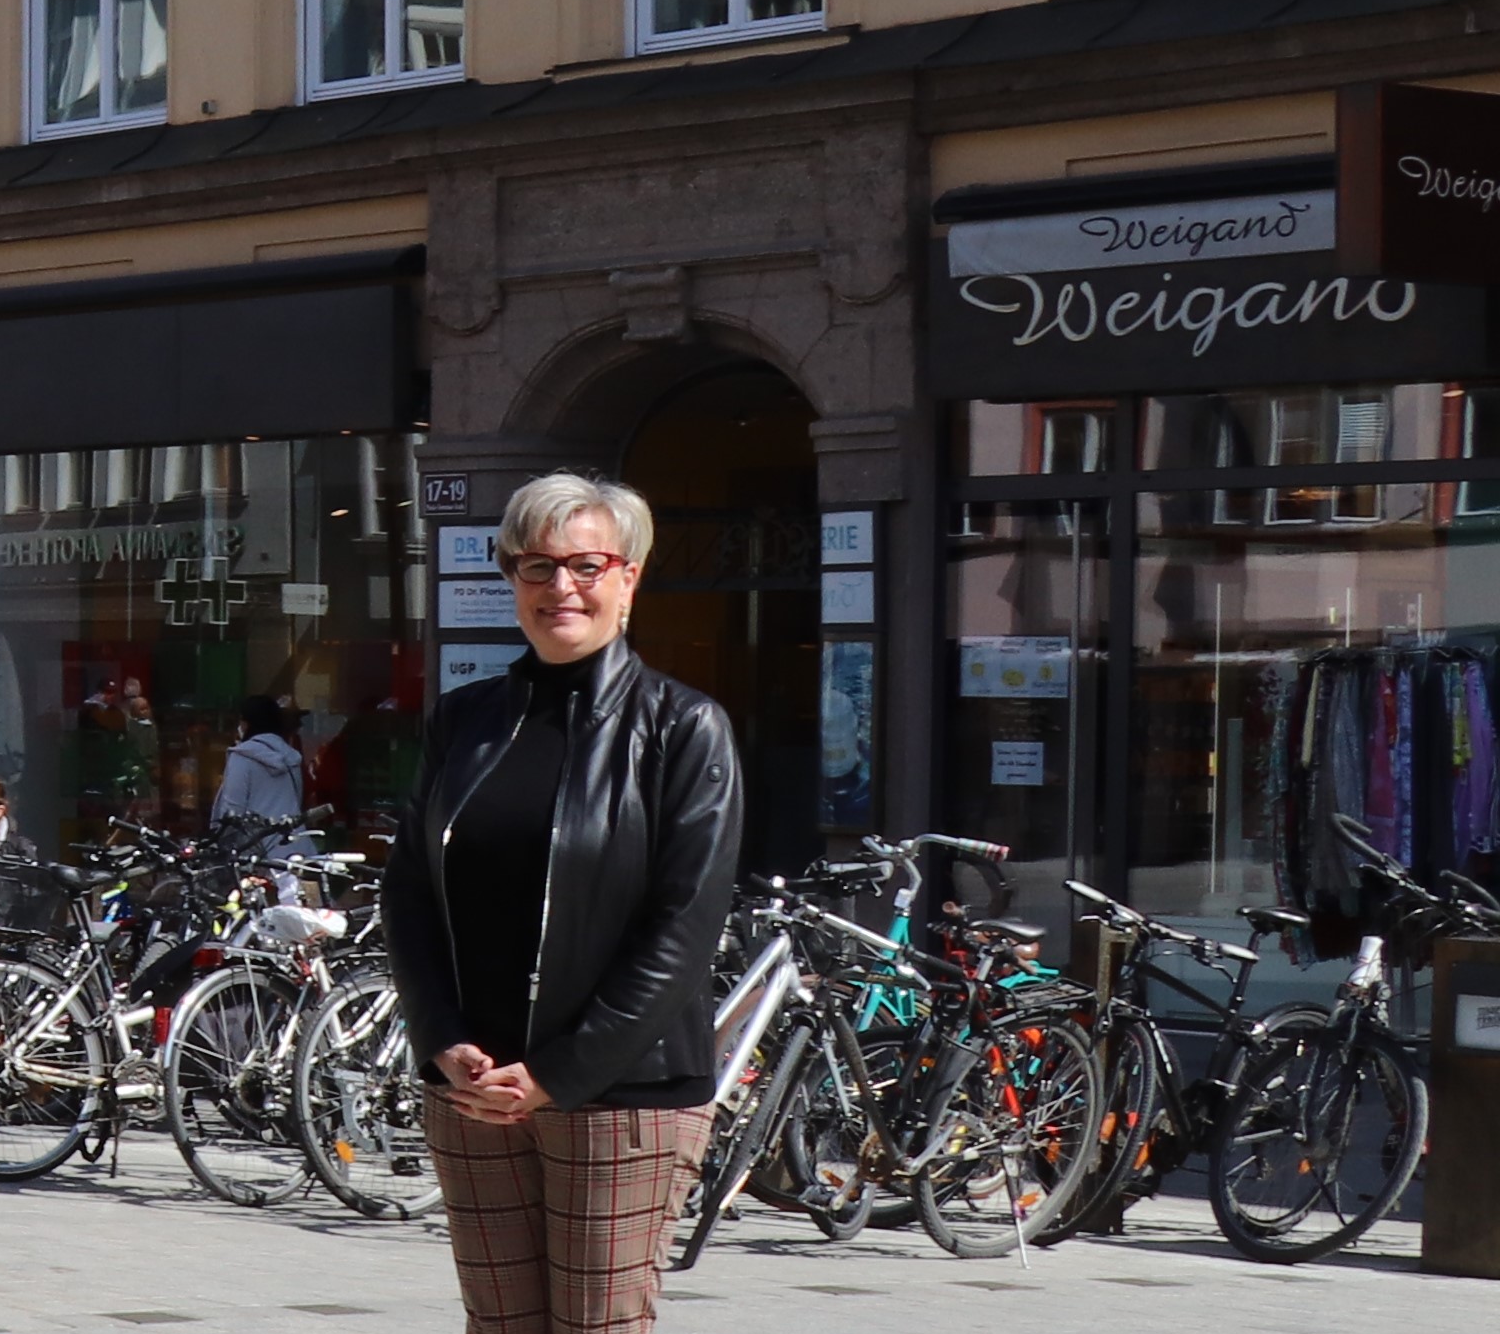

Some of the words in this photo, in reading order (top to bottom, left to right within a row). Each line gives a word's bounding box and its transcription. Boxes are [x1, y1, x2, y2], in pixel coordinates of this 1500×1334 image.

[1398, 155, 1500, 213] Weig
[1078, 201, 1311, 257] Weigand
[426, 480, 466, 502] 17-19
[450, 663, 476, 675] UGP
